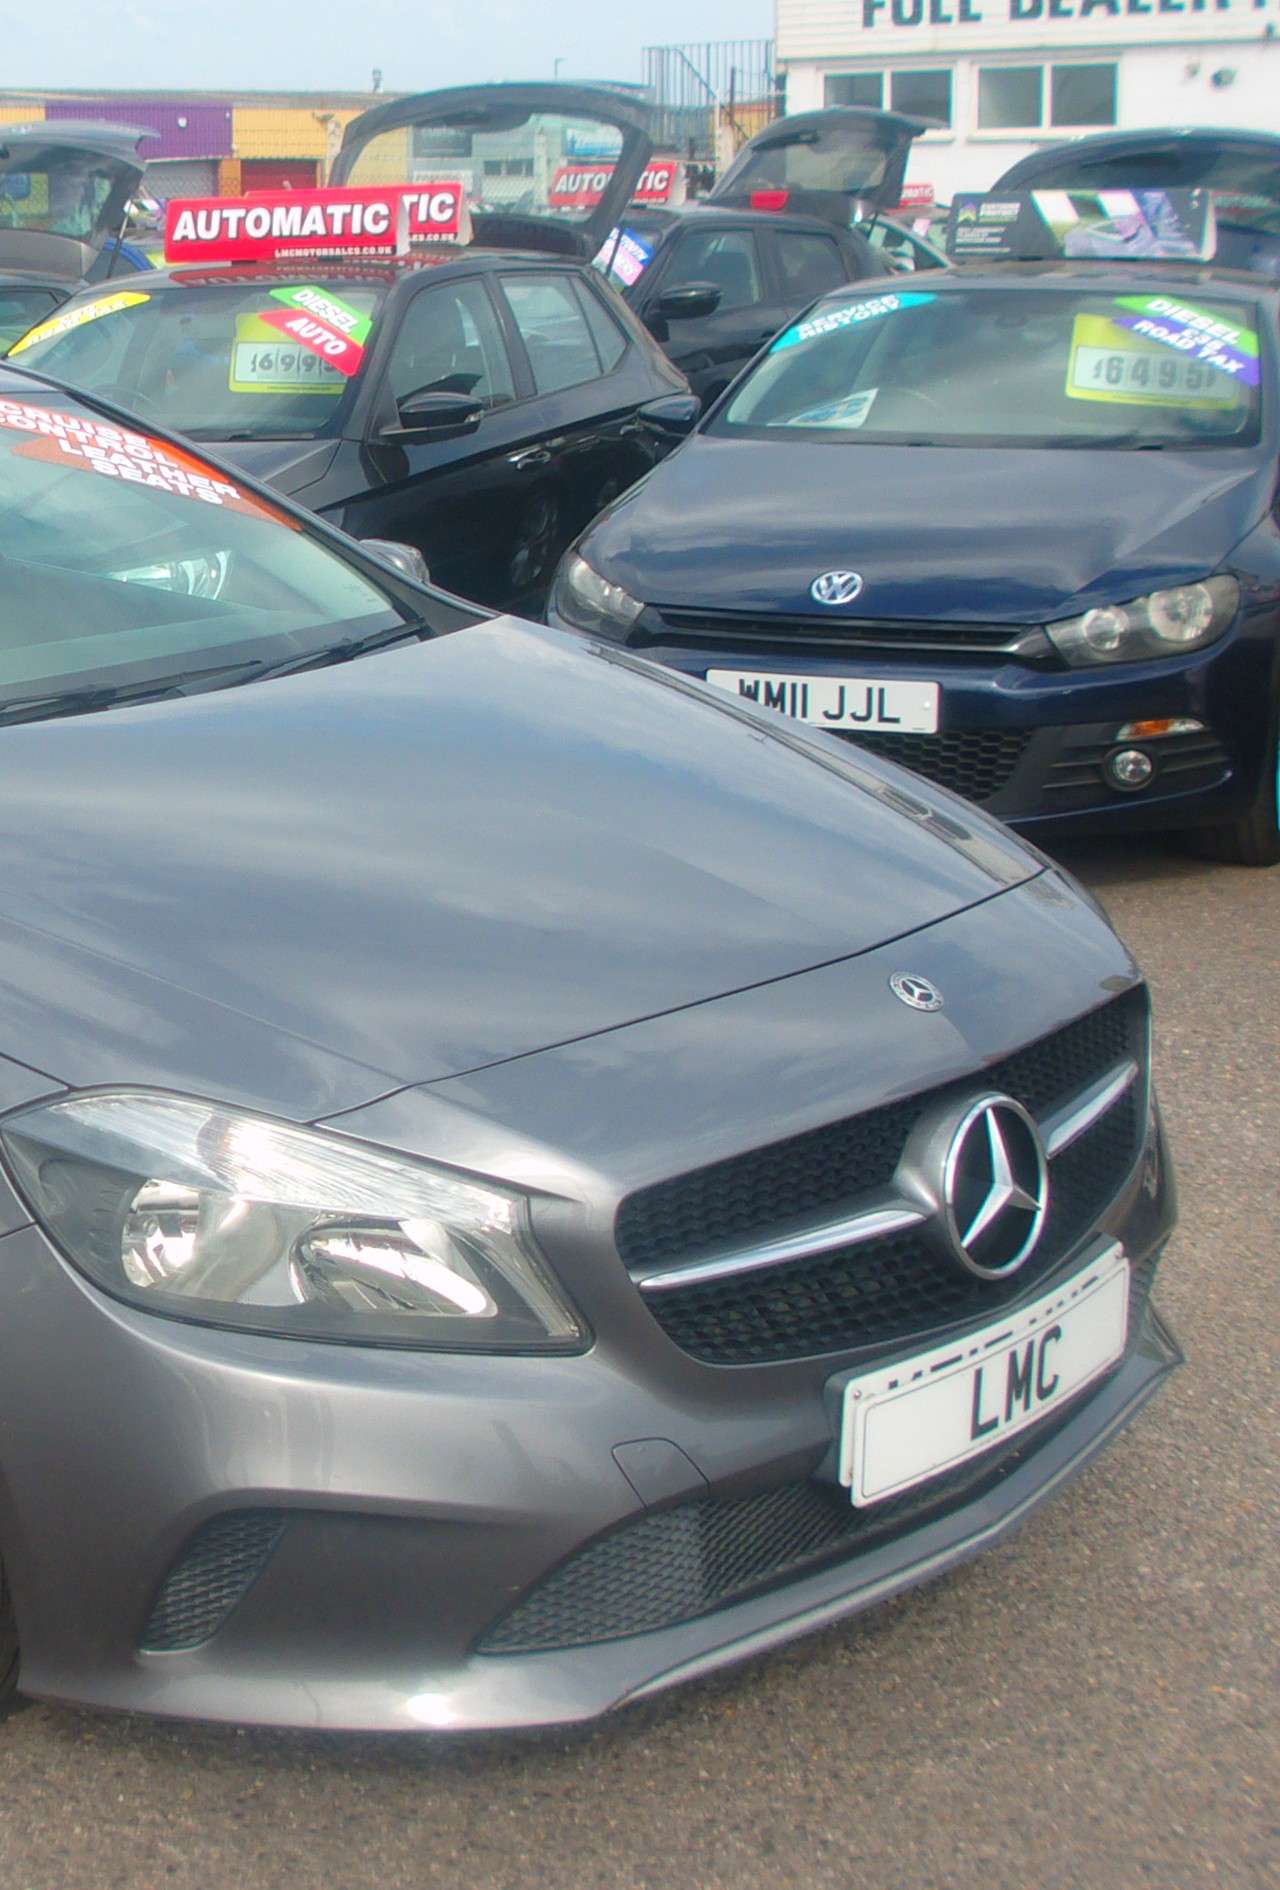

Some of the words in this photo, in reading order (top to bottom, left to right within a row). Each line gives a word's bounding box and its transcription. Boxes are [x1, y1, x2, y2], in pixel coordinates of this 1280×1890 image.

[172, 202, 390, 241] AUTOMATIC
[274, 245, 393, 258] LMCMOTORSALES.CO.UK
[291, 288, 359, 335] DIESEL
[1145, 298, 1241, 345] DIESEL
[284, 317, 348, 355] AUTO
[58, 438, 241, 500] LEATHER
[90, 459, 224, 505] SEATS
[822, 685, 901, 724] JJL
[970, 1324, 1063, 1441] LMC
